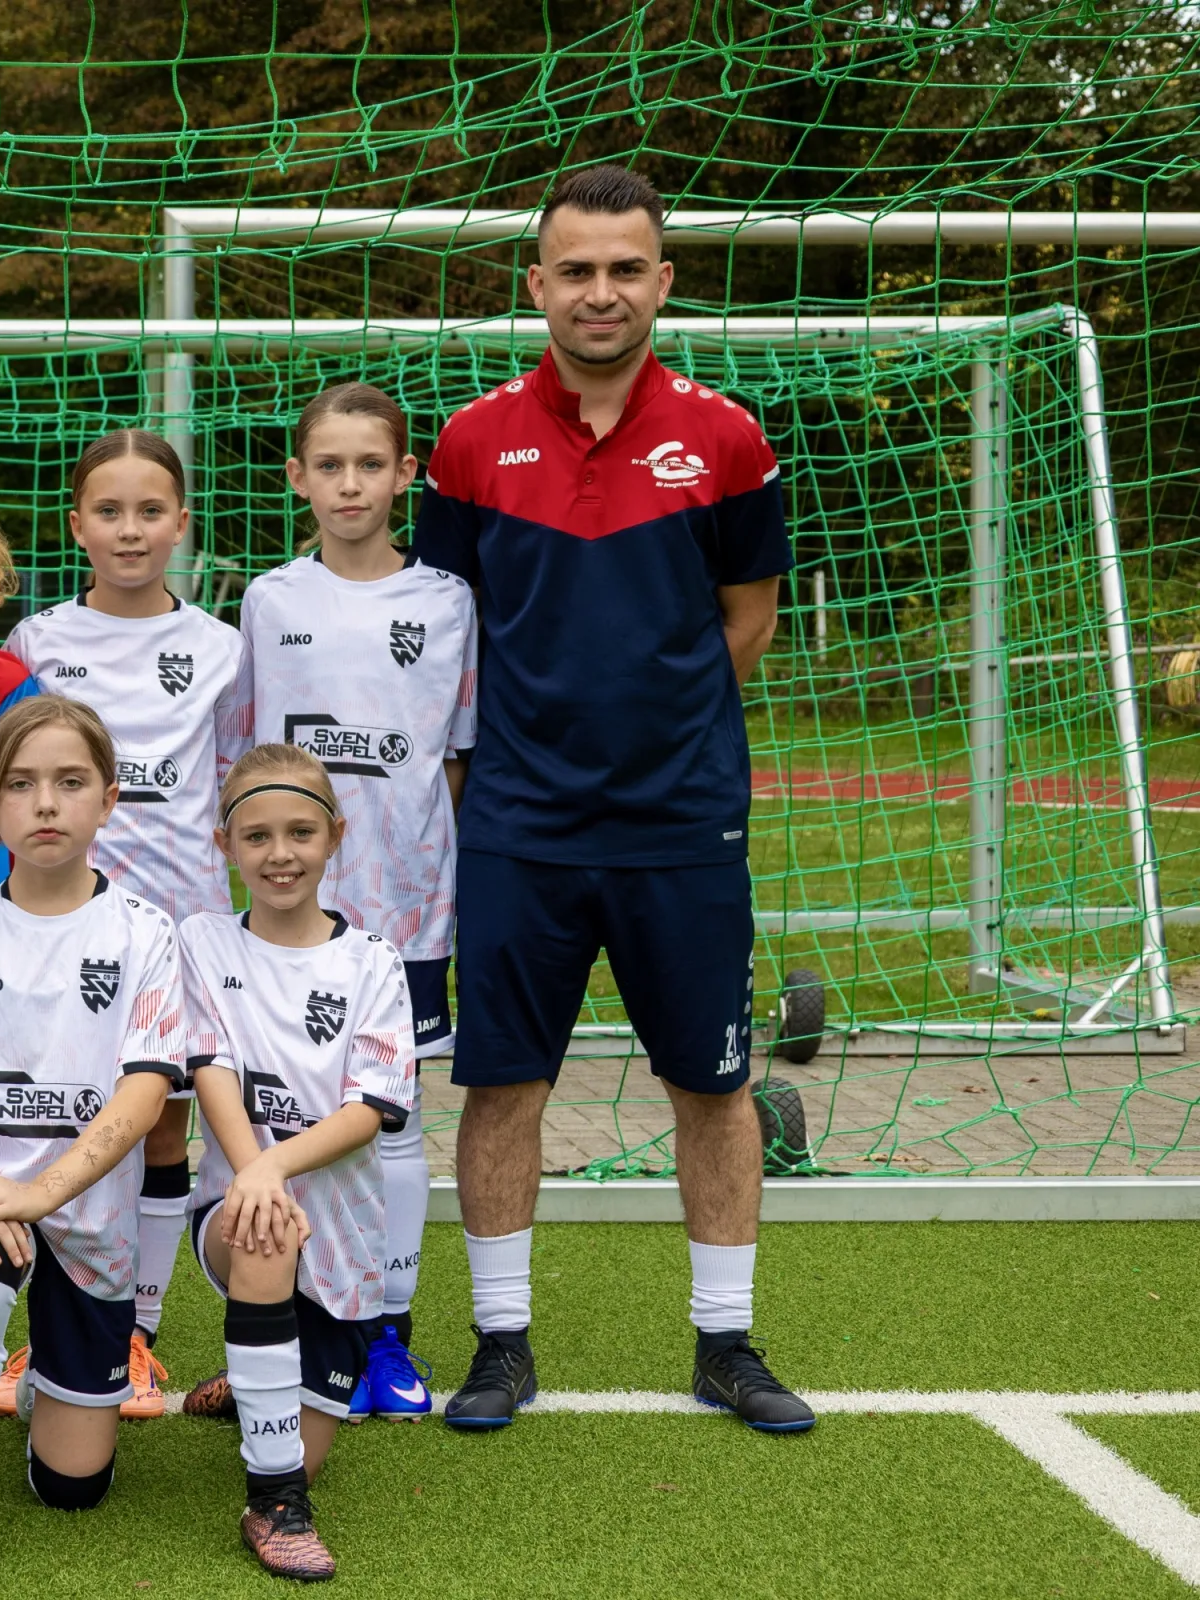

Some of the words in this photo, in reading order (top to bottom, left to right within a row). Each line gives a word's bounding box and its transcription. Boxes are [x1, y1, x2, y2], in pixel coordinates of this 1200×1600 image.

[497, 448, 540, 465] JAKO
[280, 634, 312, 646] JAKO
[55, 666, 87, 678] JAKO
[314, 729, 370, 745] SVEN
[116, 762, 147, 774] EN
[329, 1008, 346, 1017] 09/35
[416, 1015, 440, 1033] JAKO
[725, 1022, 737, 1058] 21
[6, 1088, 65, 1104] SVEN
[258, 1089, 301, 1111] SVE
[136, 1284, 158, 1296] KO
[108, 1363, 128, 1380] JAK
[328, 1371, 353, 1389] JAKO
[250, 1415, 299, 1435] JAKO
